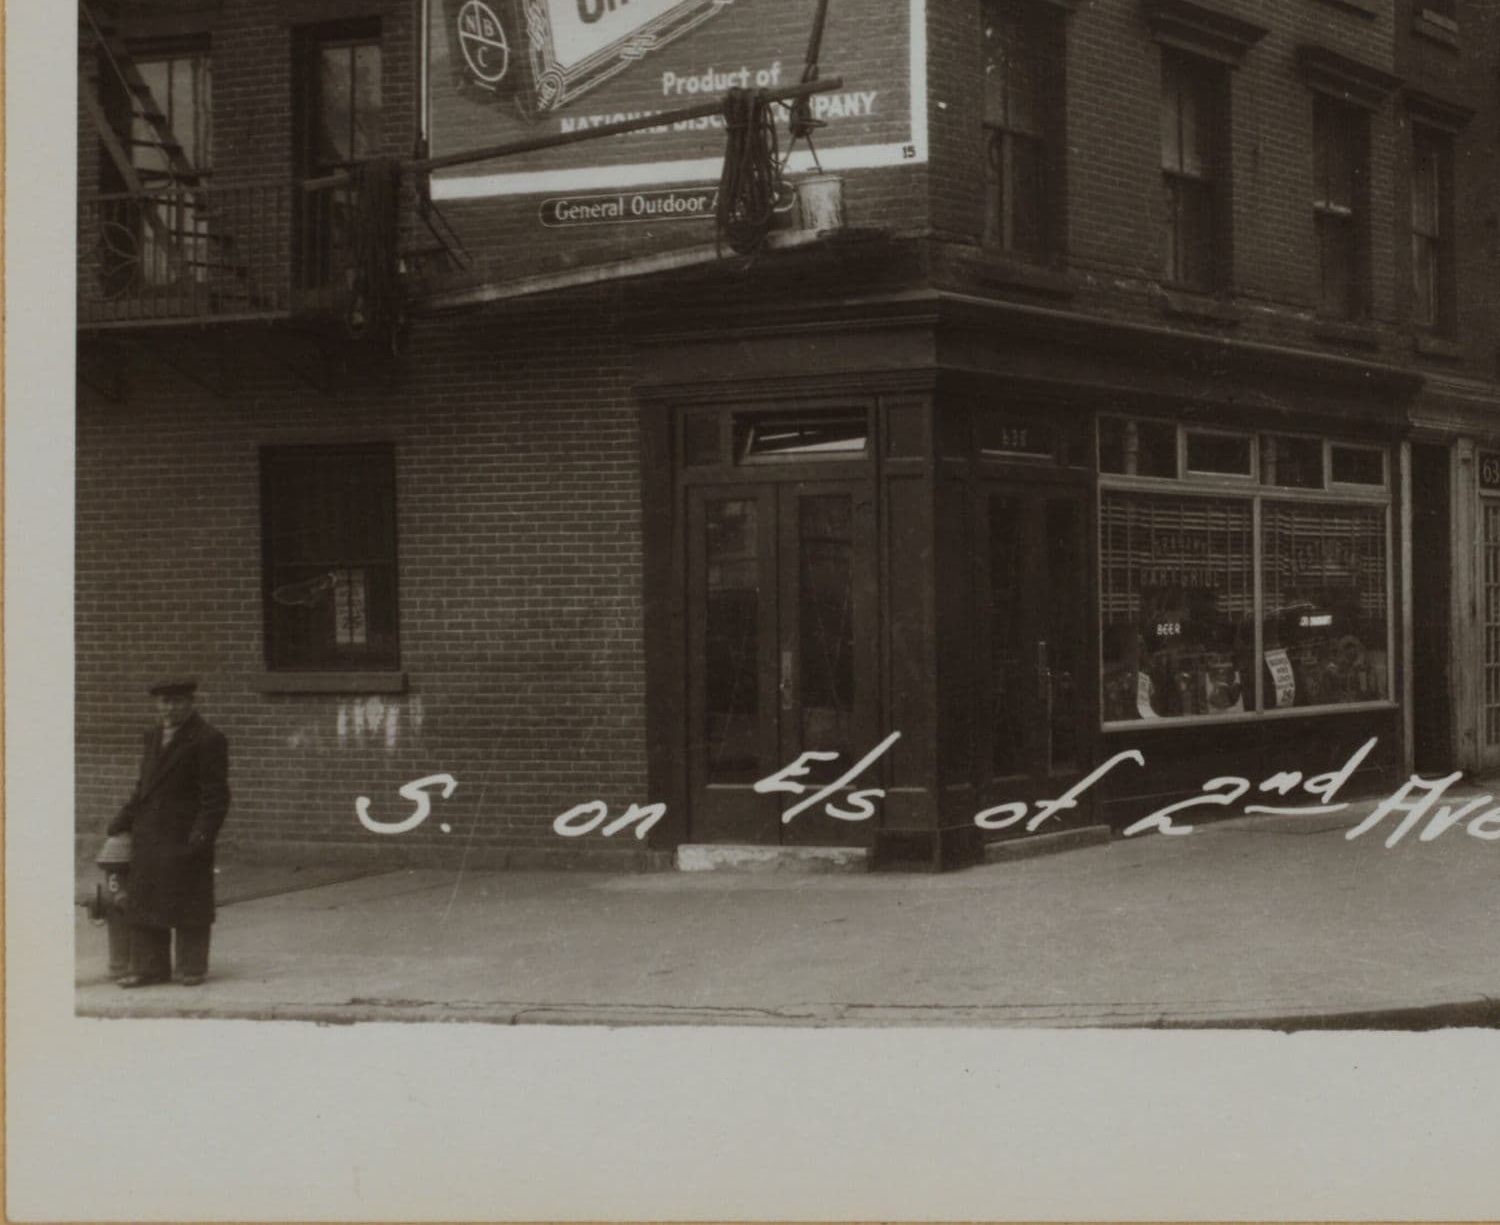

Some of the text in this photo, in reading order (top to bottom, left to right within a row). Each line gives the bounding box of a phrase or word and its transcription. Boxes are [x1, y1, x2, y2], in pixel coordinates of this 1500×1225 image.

[662, 60, 781, 96] Product of
[560, 110, 667, 136] NATIO
[765, 91, 877, 124] OPANY
[902, 146, 916, 160] 15
[554, 193, 624, 221] General
[631, 190, 706, 216] Outdoor
[1156, 622, 1181, 637] BEER
